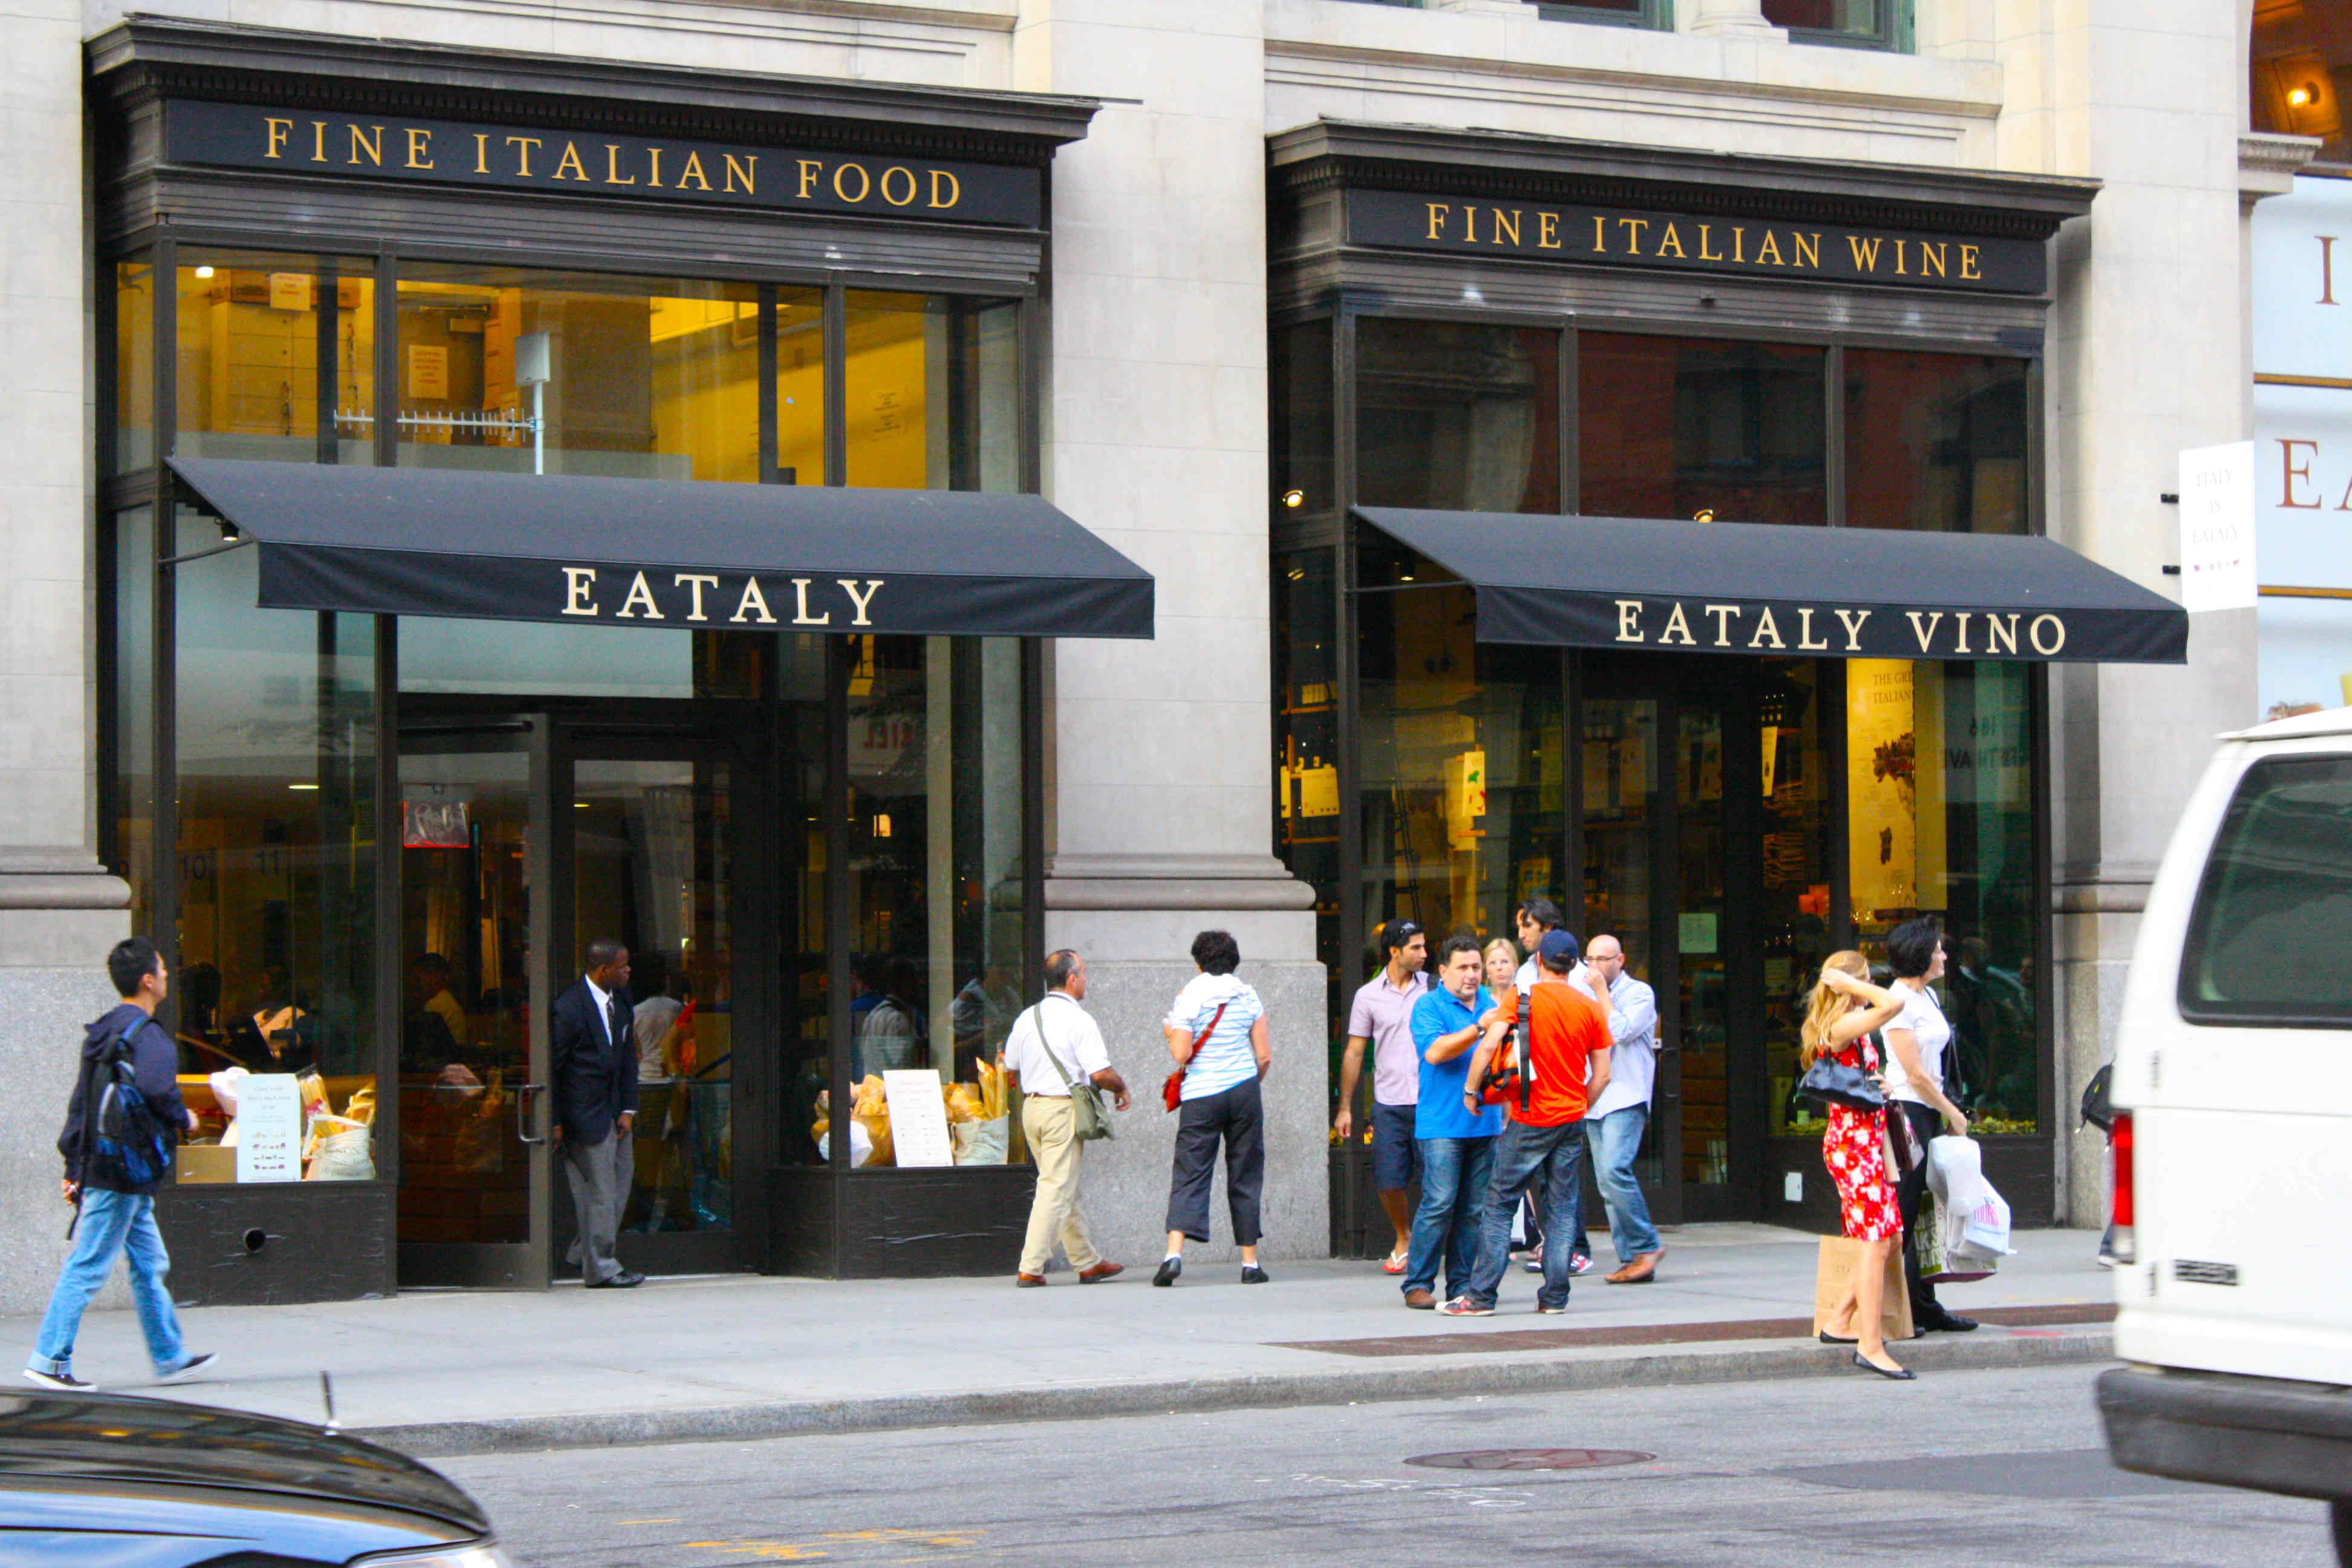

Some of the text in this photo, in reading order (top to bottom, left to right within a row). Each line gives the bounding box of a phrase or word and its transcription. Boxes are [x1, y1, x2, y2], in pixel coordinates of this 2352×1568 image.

[264, 117, 961, 209] FINE ITALIAN FOOD
[1426, 203, 1982, 280] FINE ITALIAN WINE
[2197, 469, 2233, 489] ITALY
[2274, 439, 2352, 511] E
[2207, 498, 2222, 514] IS
[2192, 523, 2240, 547] EATALY
[561, 567, 884, 626] EATALY
[1614, 600, 2066, 656] EATALY VINO
[1872, 672, 1893, 685] THE
[1873, 690, 1912, 704] ITALIAN
